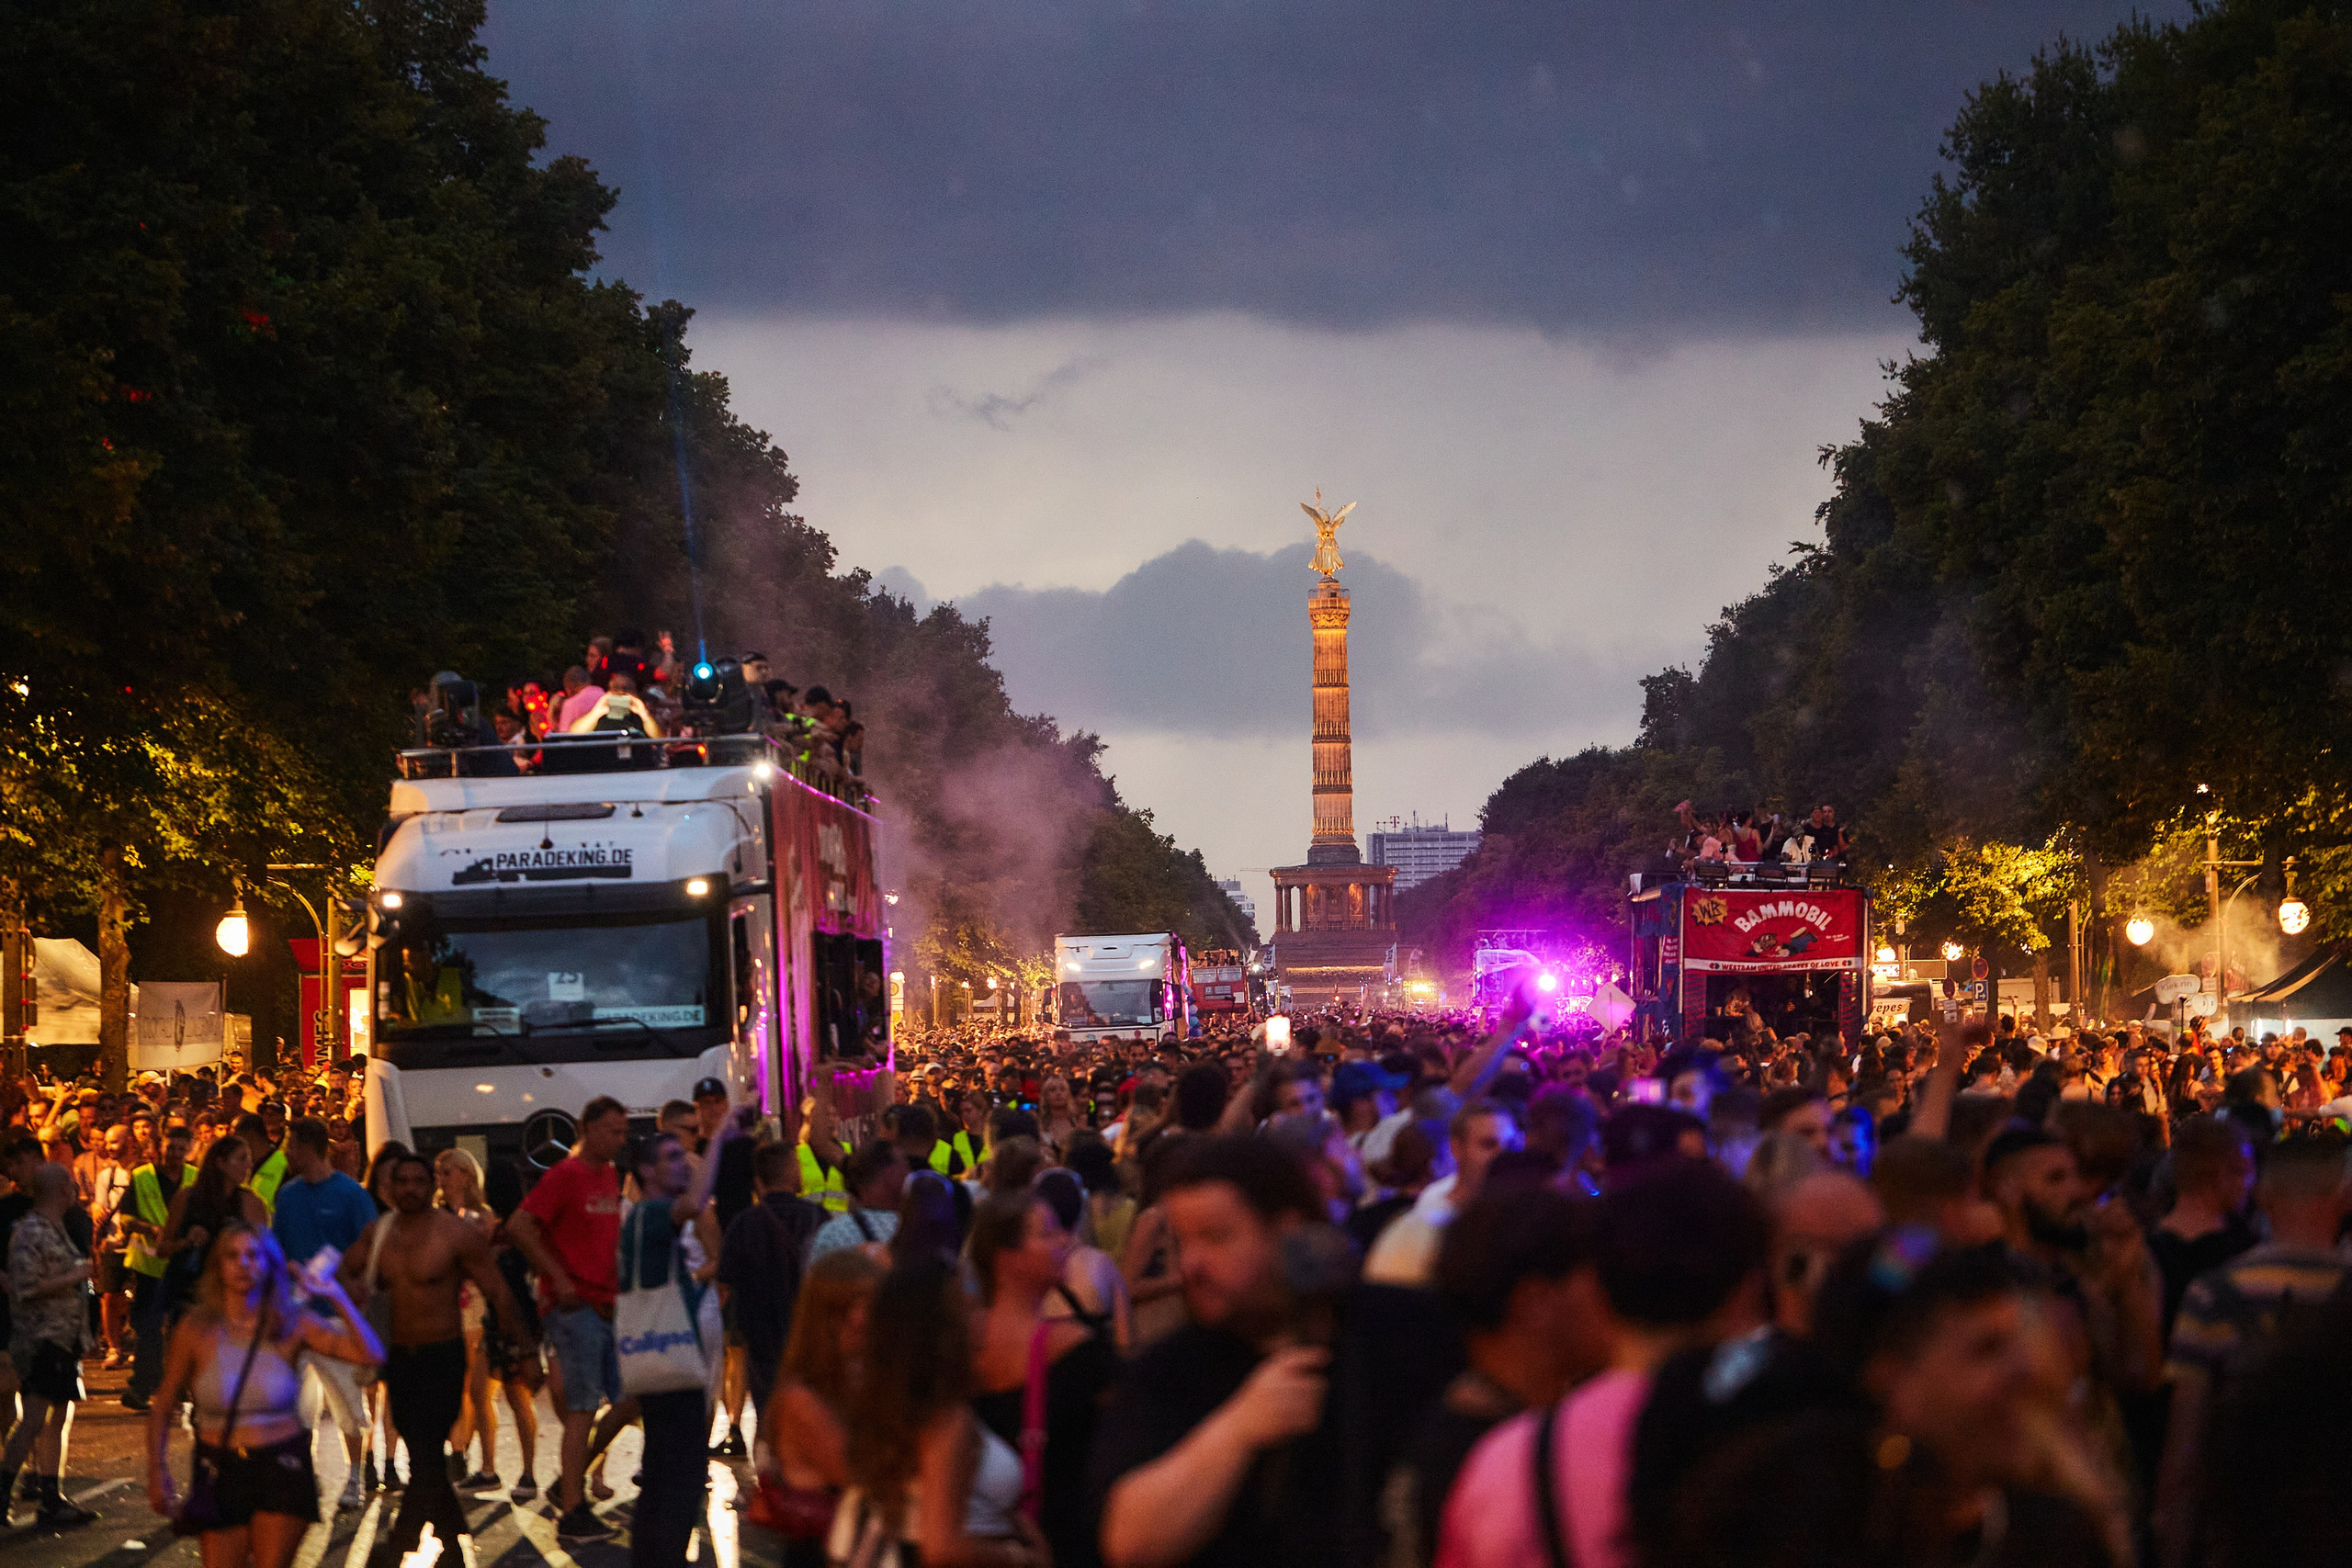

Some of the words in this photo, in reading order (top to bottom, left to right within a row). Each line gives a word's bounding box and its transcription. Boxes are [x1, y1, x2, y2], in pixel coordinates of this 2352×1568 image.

[496, 848, 633, 868] PARADEKING.DE
[1697, 899, 1723, 919] WB
[1734, 900, 1833, 933] BAMMOBIL
[1974, 982, 1984, 999] P
